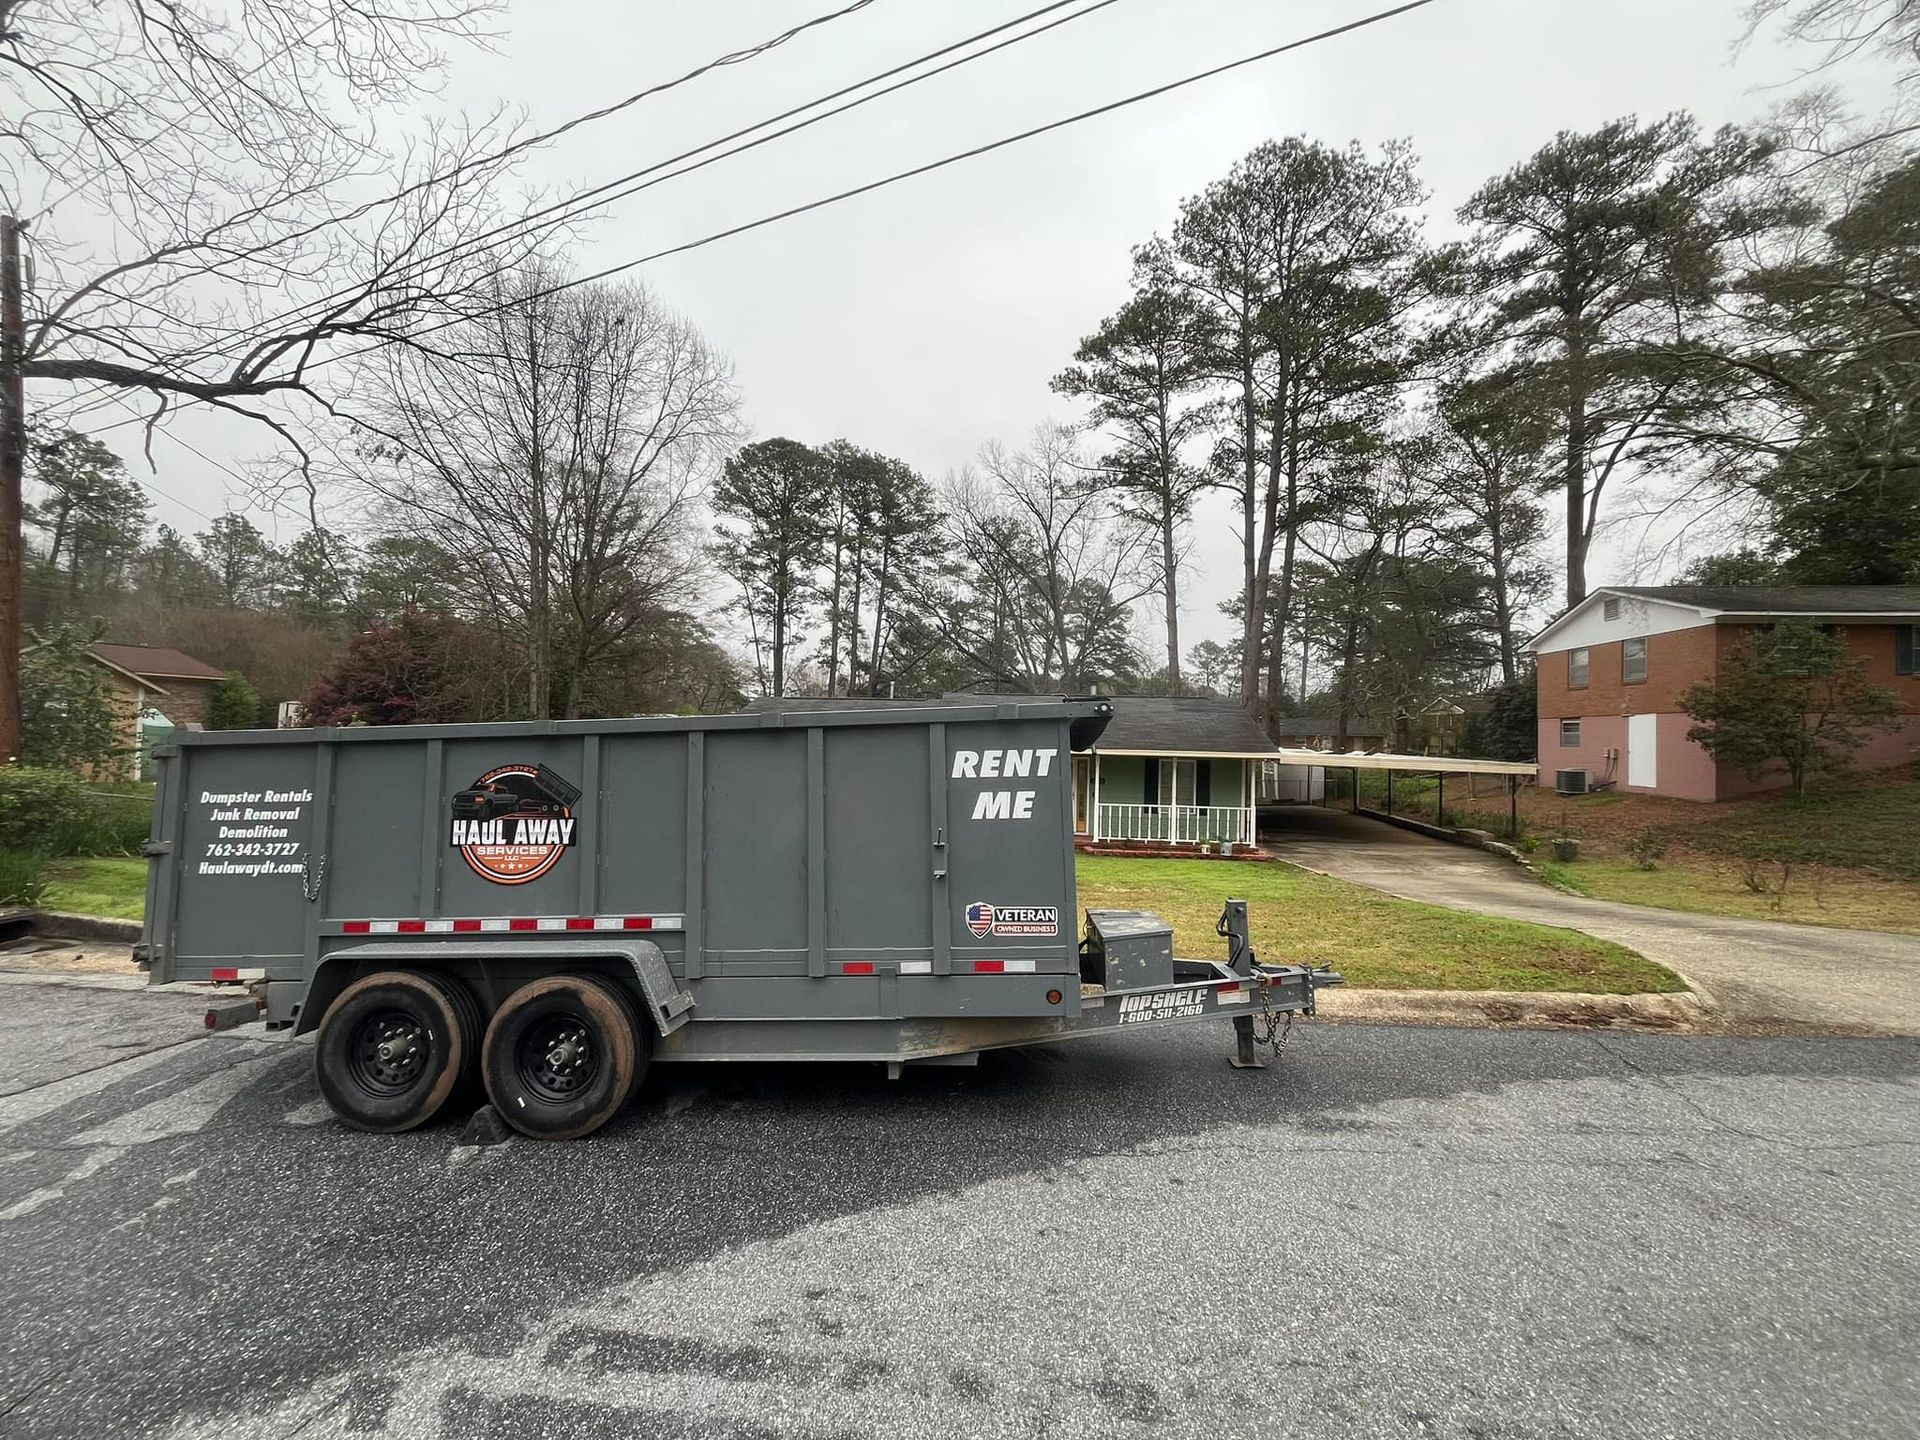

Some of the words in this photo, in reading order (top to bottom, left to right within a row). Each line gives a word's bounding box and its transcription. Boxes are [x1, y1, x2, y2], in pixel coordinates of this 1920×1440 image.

[951, 748, 1058, 778] RENT
[200, 791, 262, 807] Dumpster
[264, 789, 313, 803] Rentals
[971, 791, 1036, 820] ME
[210, 807, 241, 821] Junk
[243, 806, 301, 821] Removal
[218, 824, 288, 839] Demolition
[452, 819, 507, 845] HAUL
[513, 818, 574, 845] AWAY
[205, 842, 300, 857] 762-342-3727
[476, 846, 549, 856] SERVICES
[198, 860, 304, 877] Haulawaydt.com
[996, 909, 1055, 921] VETERAN
[997, 925, 1023, 933] OWNED
[1023, 925, 1055, 933] BUSINESS
[1118, 1004, 1204, 1024] 1-800-511-2168
